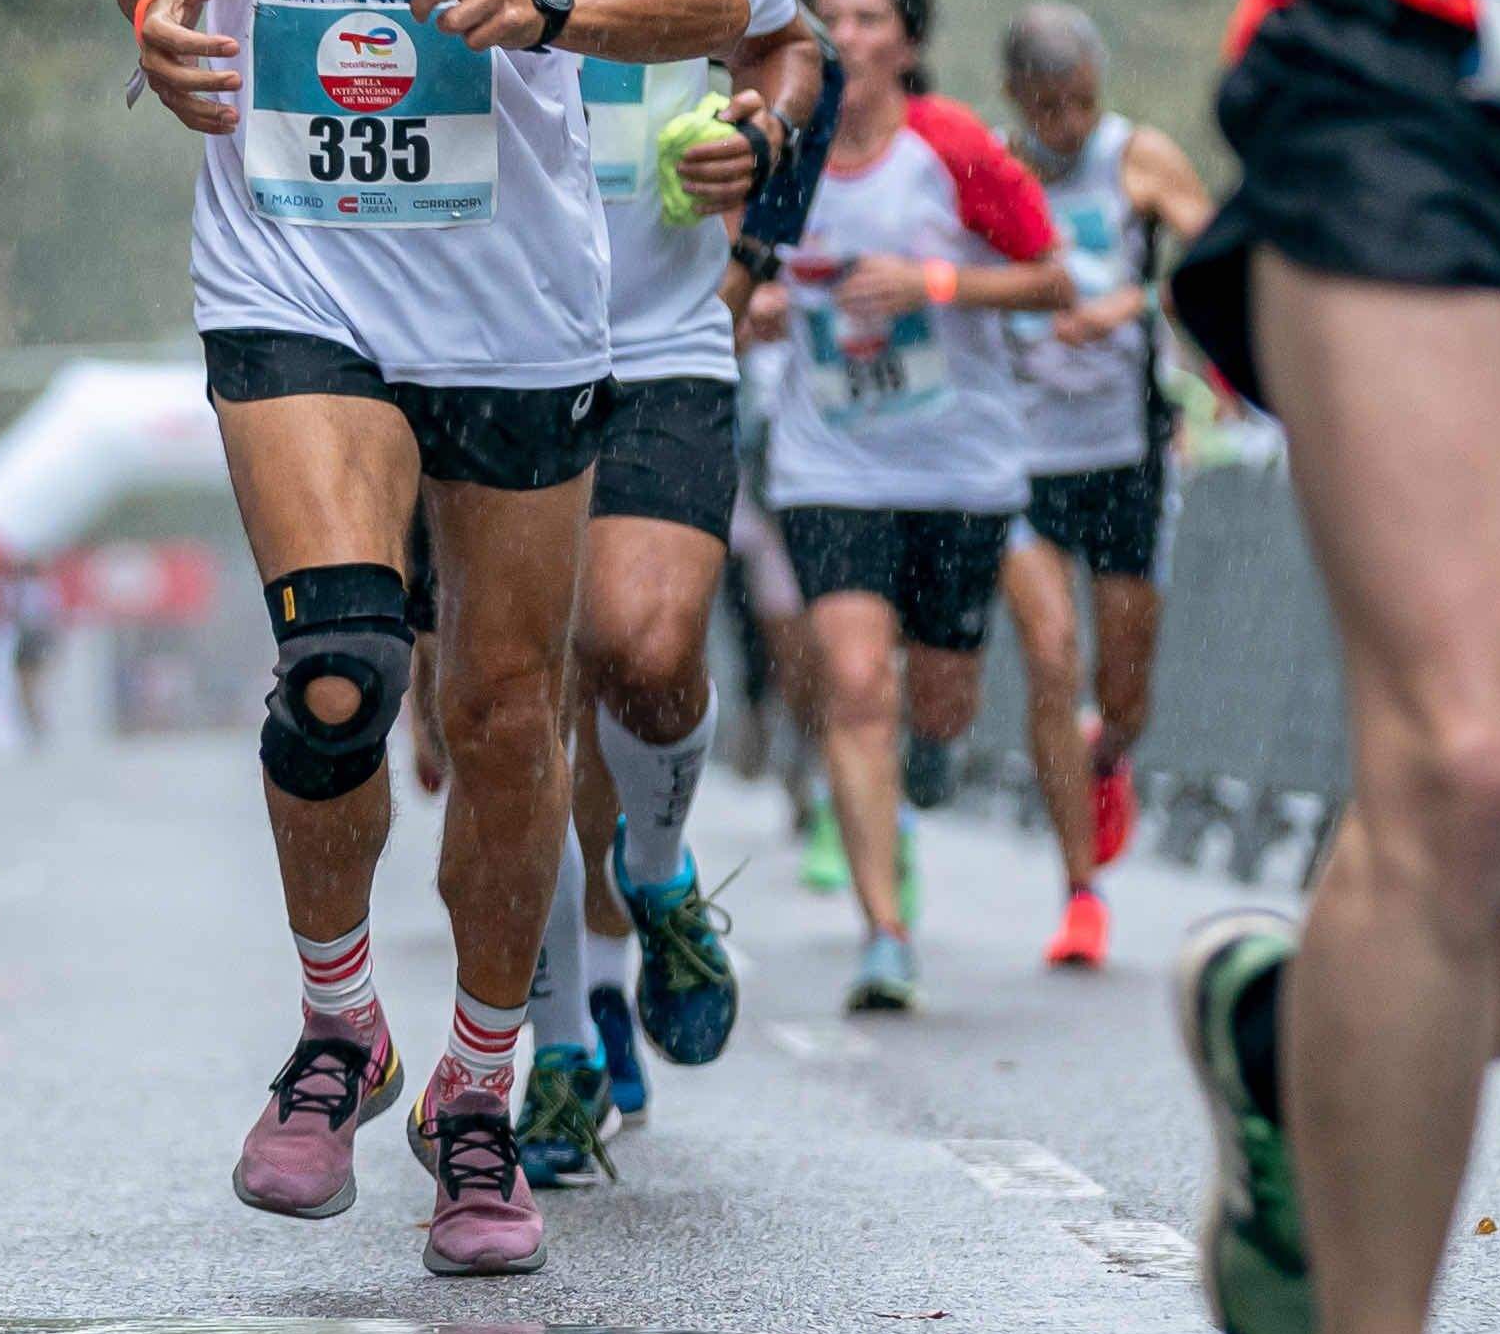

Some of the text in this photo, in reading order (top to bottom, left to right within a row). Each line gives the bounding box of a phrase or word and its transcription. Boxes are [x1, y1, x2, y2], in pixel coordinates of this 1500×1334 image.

[353, 77, 382, 87] MILLA
[343, 96, 355, 104] DE
[308, 115, 431, 183] 335
[271, 194, 324, 209] MADRID
